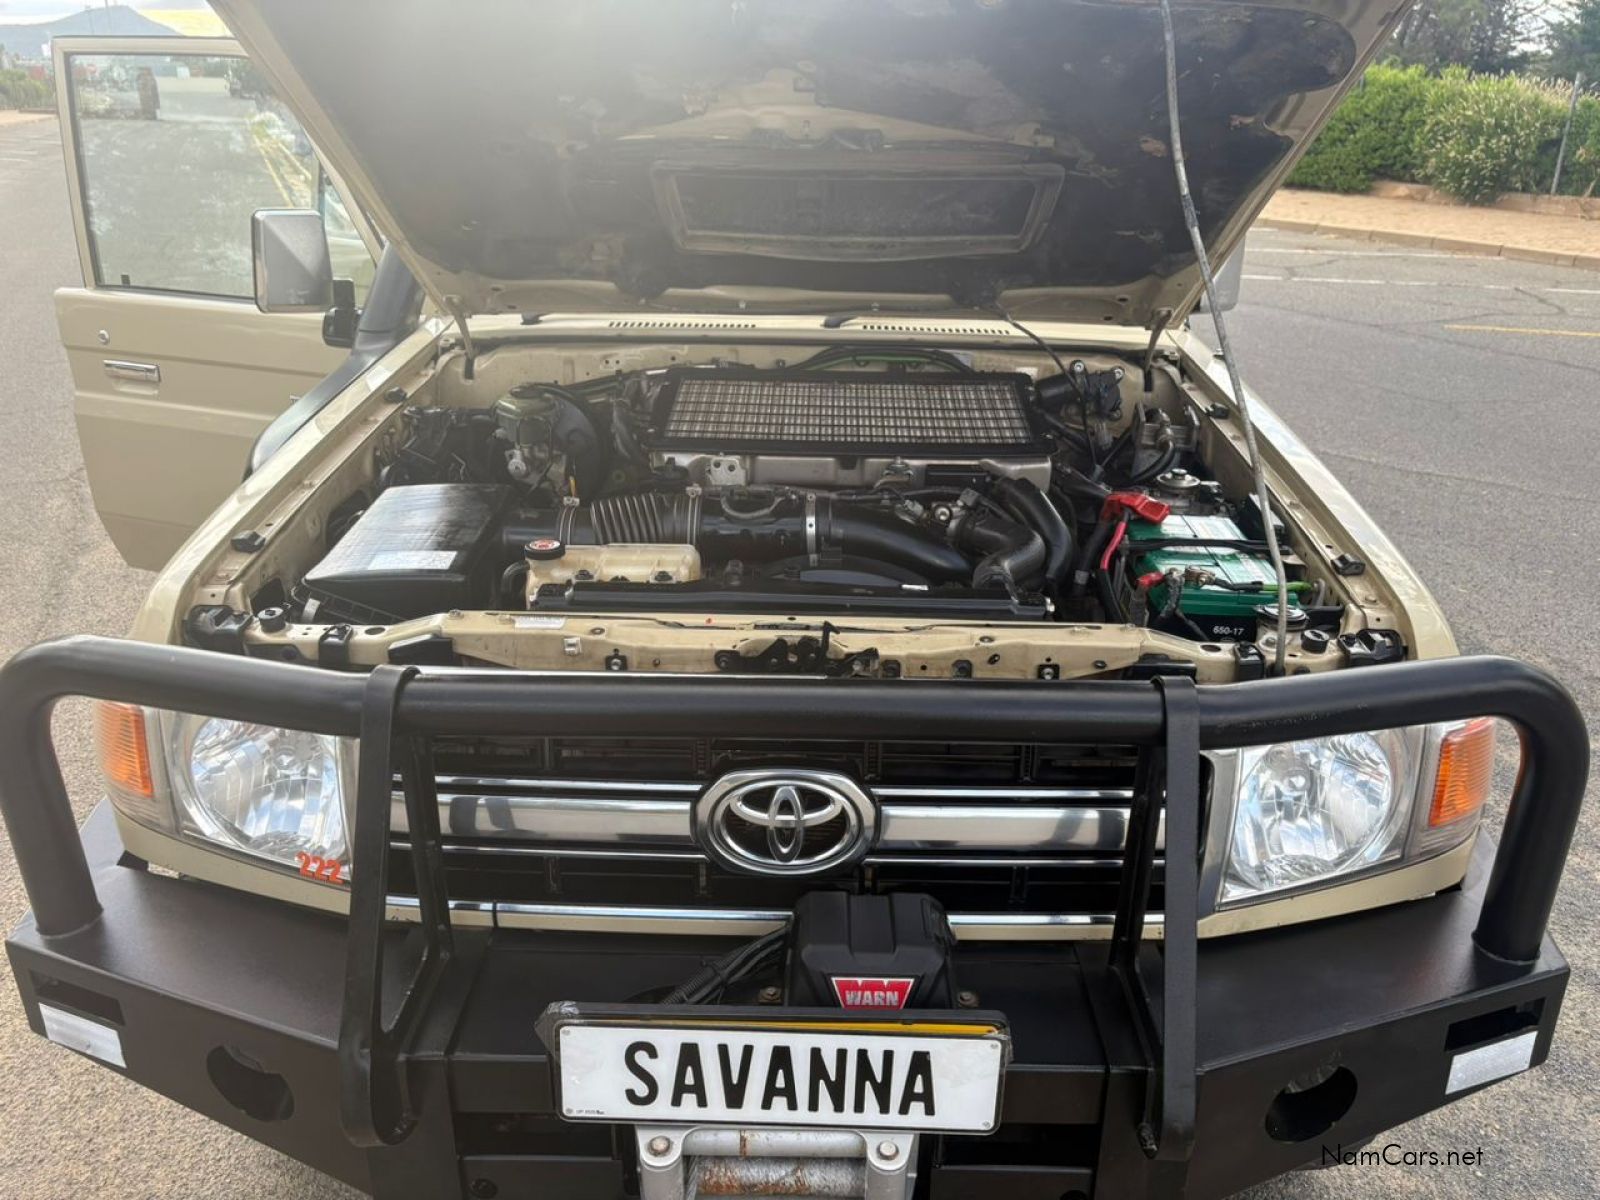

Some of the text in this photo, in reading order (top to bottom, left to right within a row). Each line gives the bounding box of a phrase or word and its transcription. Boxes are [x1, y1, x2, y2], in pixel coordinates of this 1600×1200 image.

[1213, 625, 1245, 636] 650-17
[295, 850, 345, 886] 222
[845, 989, 899, 1006] WARN
[624, 1041, 935, 1116] SAVANNA
